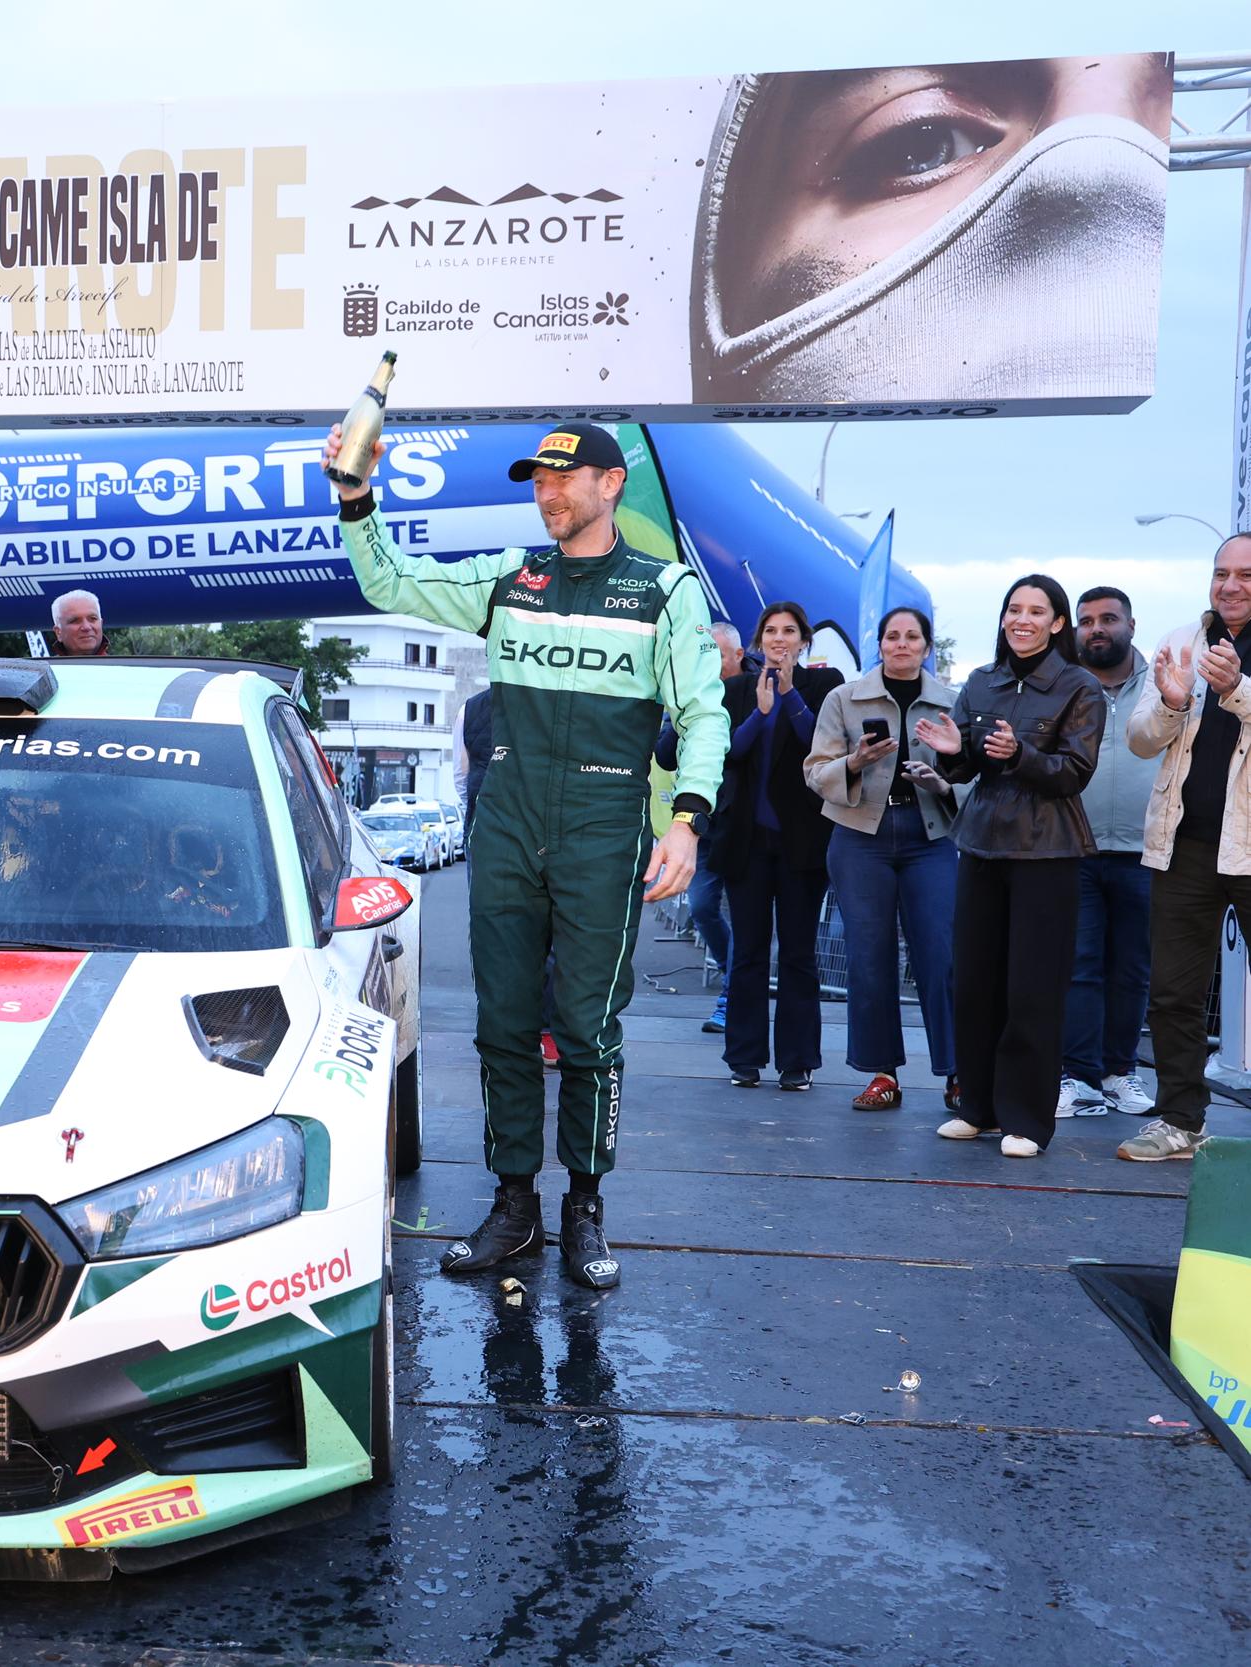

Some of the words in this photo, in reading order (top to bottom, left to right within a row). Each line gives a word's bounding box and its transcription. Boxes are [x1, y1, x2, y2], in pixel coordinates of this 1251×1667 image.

[99, 173, 166, 265] ISLA
[179, 172, 219, 261] DE
[349, 214, 624, 249] LANZAROTE
[415, 259, 431, 268] LA
[439, 258, 470, 267] ISLA
[476, 256, 555, 266] DIFERENTE
[19, 286, 38, 303] de
[44, 276, 130, 316] Arrecife
[385, 300, 452, 315] Cabildo
[458, 299, 480, 314] de
[541, 293, 589, 311] Islas
[385, 317, 474, 332] Lanzarote
[493, 311, 589, 328] Canarias
[21, 339, 29, 360] de
[32, 329, 86, 360] RALLYES
[89, 337, 97, 358] de
[100, 328, 156, 361] ASFALTO
[6, 366, 30, 396] LAS
[32, 365, 83, 396] PALMAS
[85, 380, 90, 393] e
[93, 363, 149, 395] INSULAR
[152, 371, 160, 392] de
[164, 361, 244, 393] LANZAROTE
[384, 411, 632, 422] Orvecam
[711, 406, 999, 419] Orvecame
[77, 477, 168, 498] INSULAR
[173, 474, 201, 494] DE
[149, 532, 196, 560] DE
[208, 519, 429, 556] LANZATE
[605, 597, 639, 609] DAG
[581, 765, 632, 775] LUKYANUK
[351, 882, 396, 914] AVIS
[362, 899, 403, 922] Canarias
[336, 1012, 385, 1072] DORAL
[245, 1248, 352, 1312] Castrol
[1209, 1371, 1238, 1391] bp
[64, 1485, 200, 1546] PIRELLI
